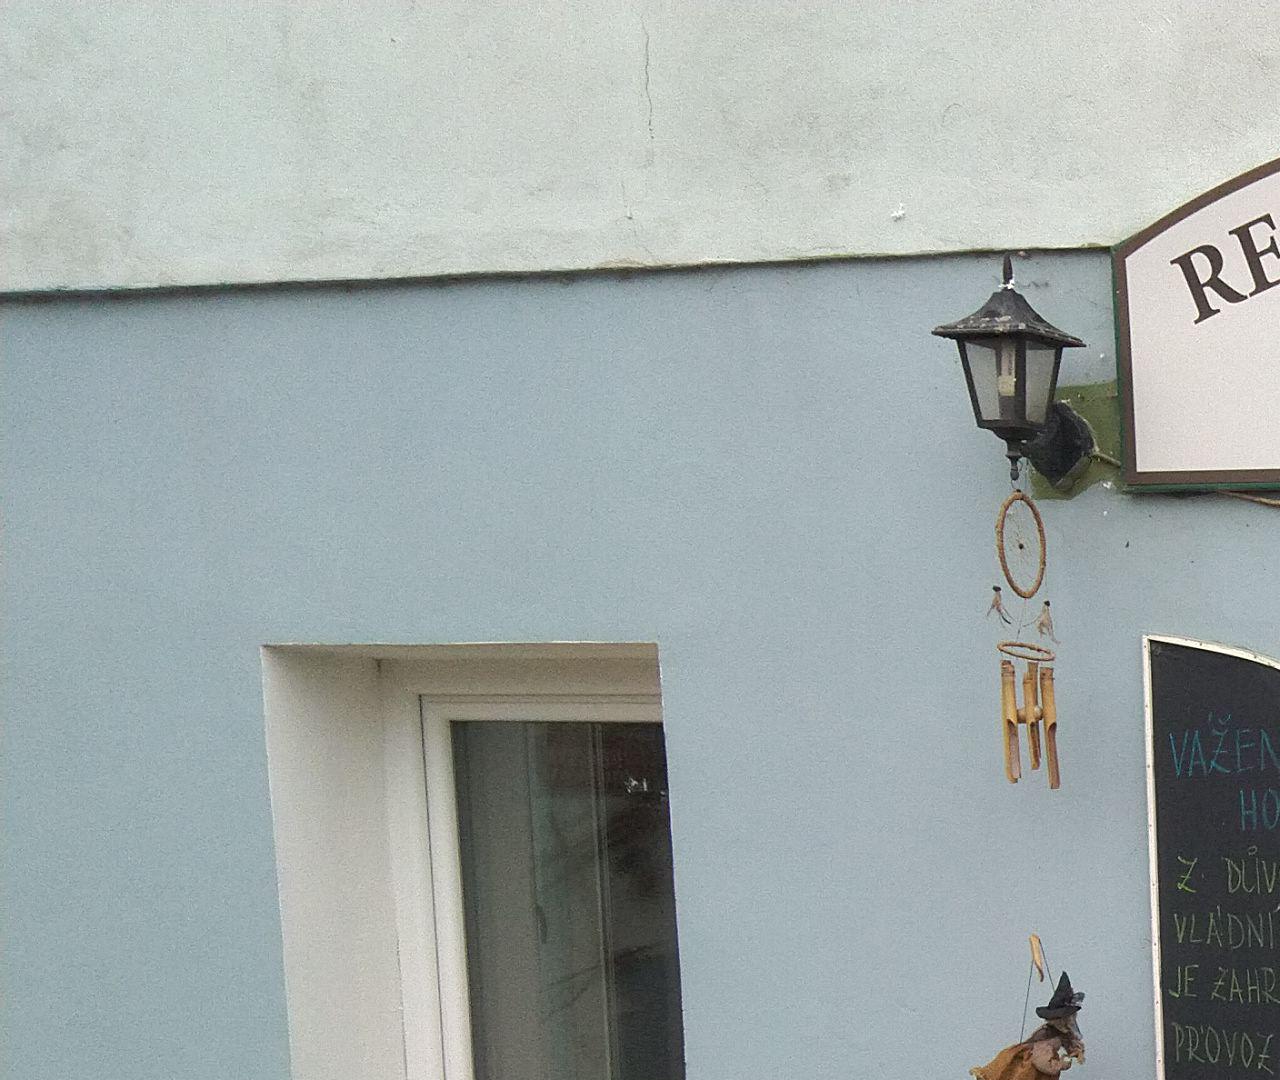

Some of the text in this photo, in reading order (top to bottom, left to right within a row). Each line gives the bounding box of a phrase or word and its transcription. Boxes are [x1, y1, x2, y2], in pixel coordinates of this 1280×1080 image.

[1177, 855, 1197, 893] Z
[1169, 964, 1199, 998] JE
[1171, 1022, 1274, 1076] PROVOZ
